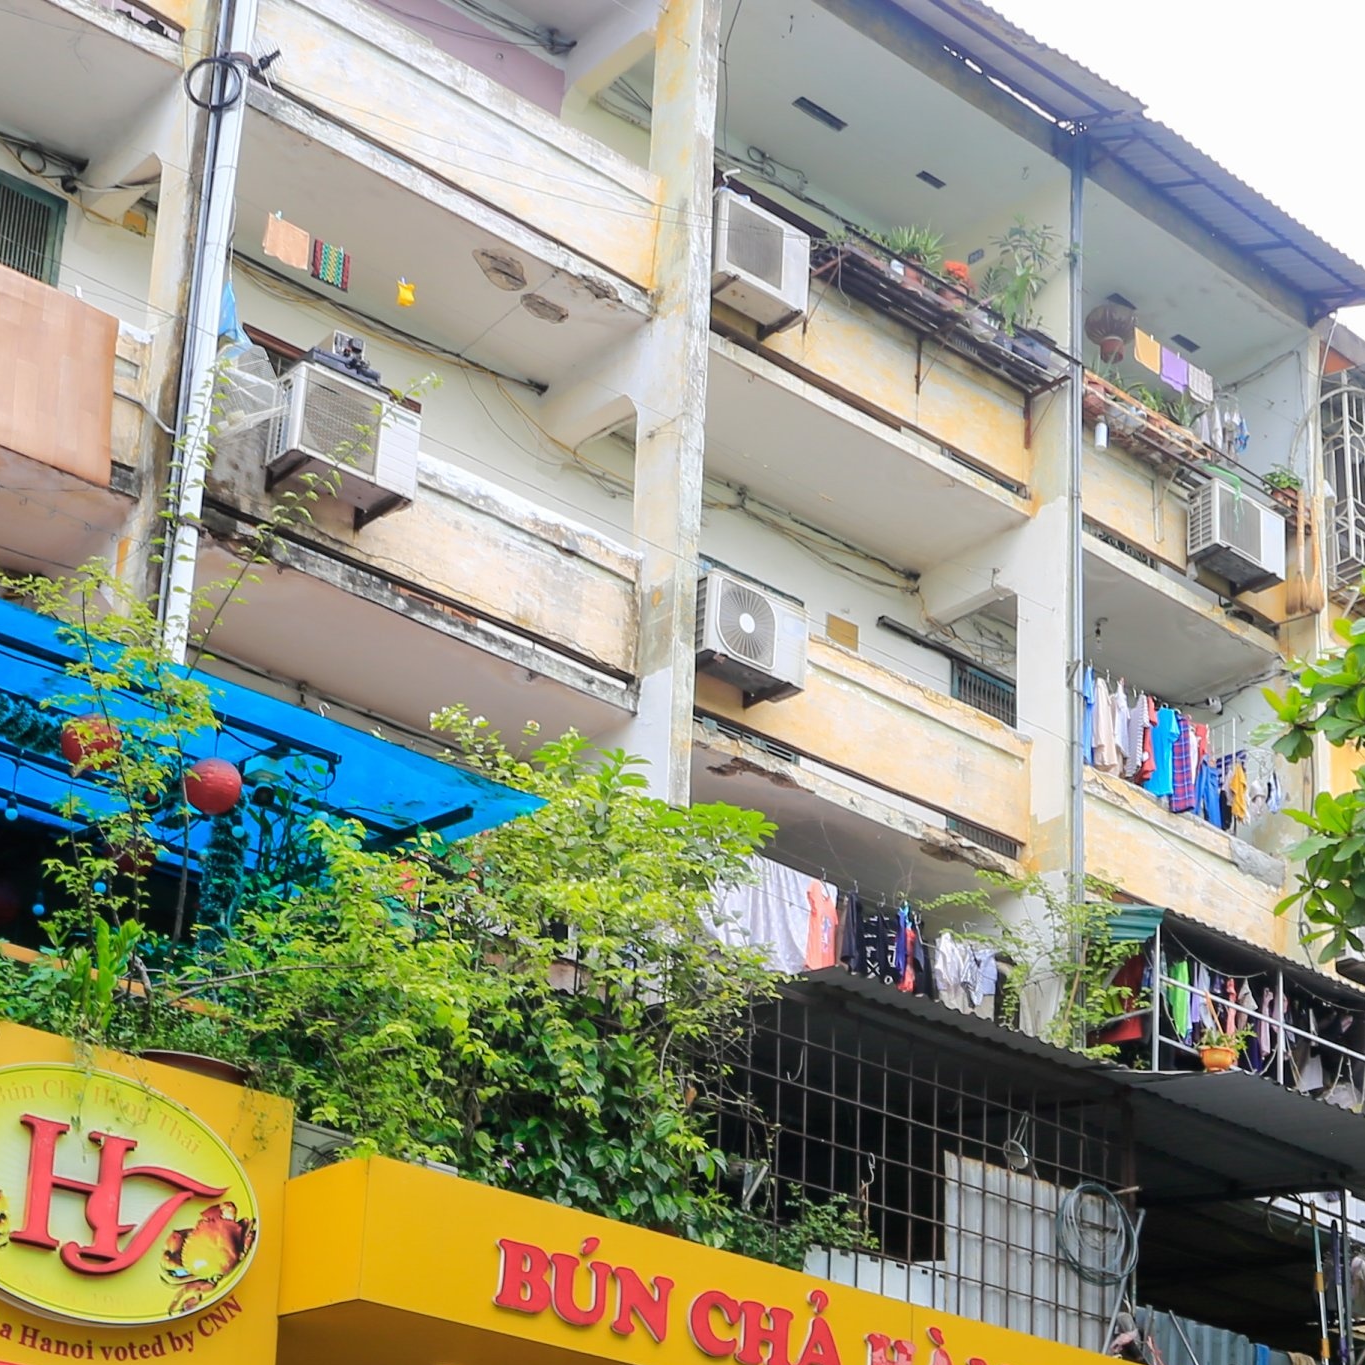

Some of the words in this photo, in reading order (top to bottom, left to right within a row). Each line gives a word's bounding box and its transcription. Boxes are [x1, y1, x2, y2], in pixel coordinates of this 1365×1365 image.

[18, 1324, 95, 1361] Hanoi
[99, 1331, 165, 1362] voted
[168, 1326, 196, 1354] by
[195, 1293, 246, 1340] CNN
[493, 1236, 674, 1344] BÚN
